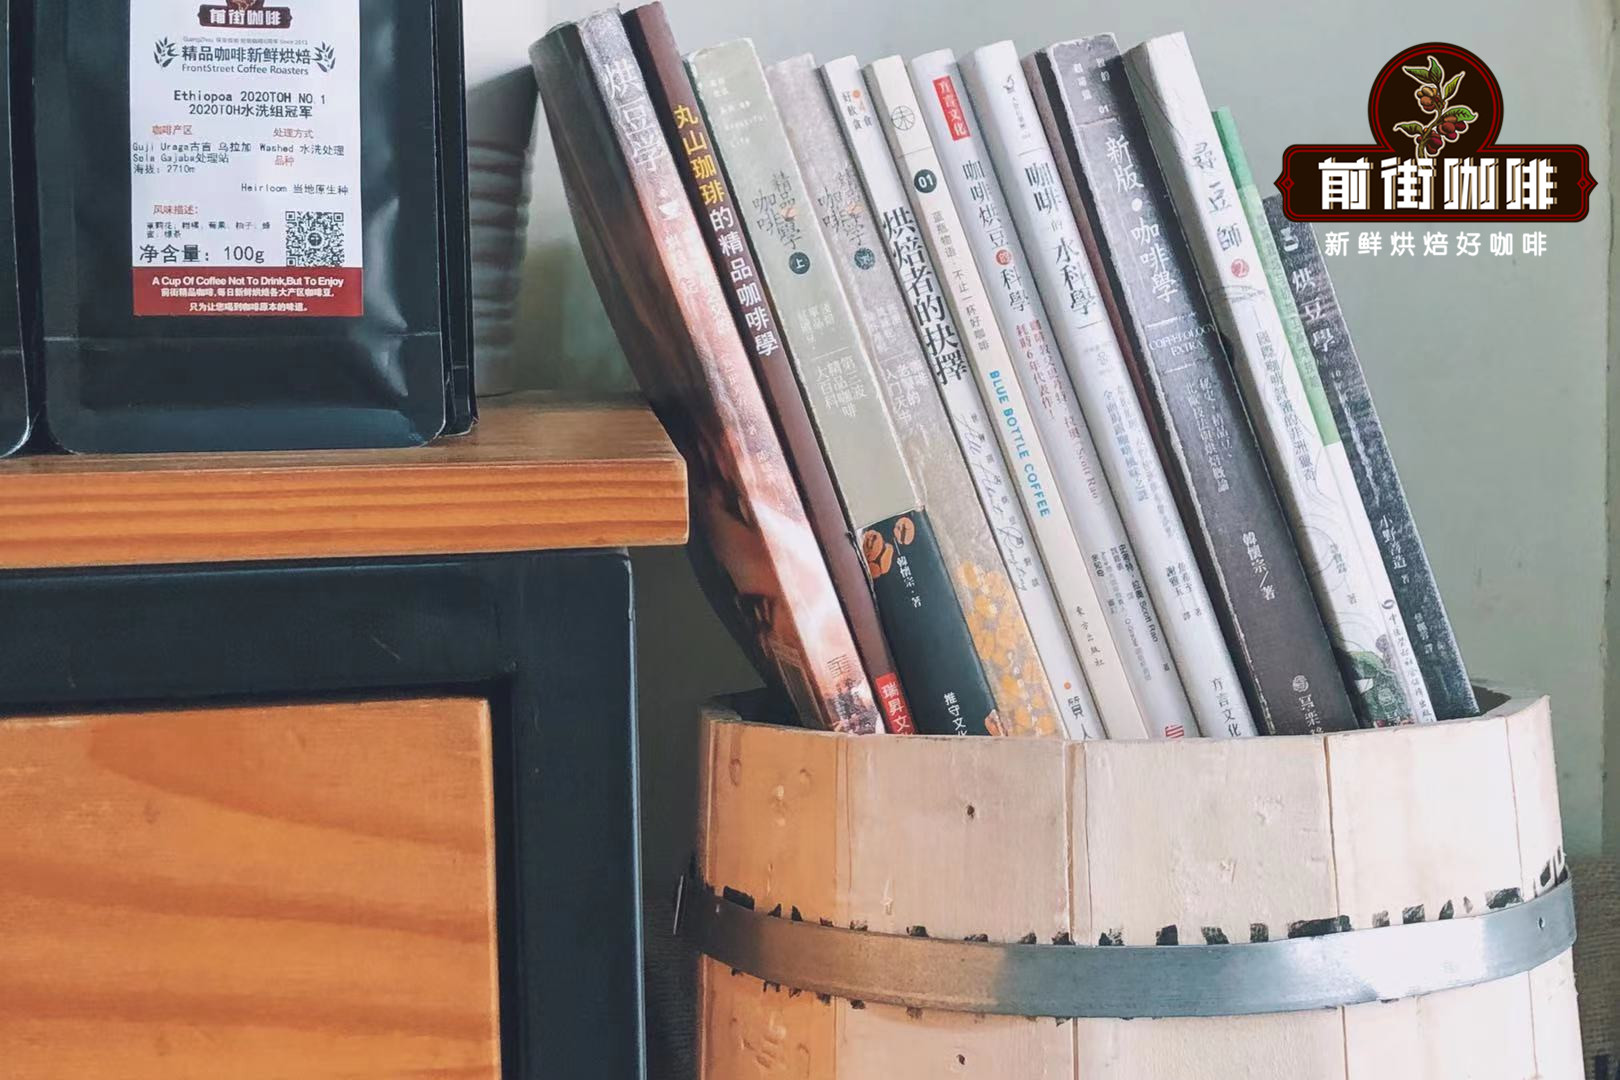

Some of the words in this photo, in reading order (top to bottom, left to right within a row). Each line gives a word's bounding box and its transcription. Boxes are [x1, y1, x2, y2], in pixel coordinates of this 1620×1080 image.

[209, 8, 282, 26] 前街咖啡
[182, 45, 312, 64] 精品咖啡新鲜烘焙
[182, 64, 235, 73] FrontStreet
[237, 65, 267, 73] Coffee
[270, 66, 309, 75] Roasters
[174, 90, 232, 103] Ethiopoa
[241, 91, 292, 103] 2020TOH
[189, 105, 313, 118] 2020TOH水洗组冠军
[152, 124, 193, 135] 咖啡产区
[273, 128, 314, 139] 处理方式
[259, 143, 294, 153] Washed
[299, 144, 345, 156] 水洗处理
[274, 155, 295, 167] 品种
[918, 174, 935, 189] 01
[241, 183, 288, 193] Heirloom
[293, 183, 349, 196] 当地原生种
[223, 245, 266, 264] 100g
[152, 276, 160, 286] A
[161, 276, 182, 288] Cup
[183, 276, 194, 286] Of
[195, 276, 227, 286] Coffee
[228, 276, 245, 286] Not
[246, 276, 259, 286] To
[304, 277, 317, 287] To
[318, 277, 345, 288] Enjoy
[989, 370, 1009, 405] BLUE
[1003, 407, 1030, 460] BOTTLE
[1024, 463, 1051, 518] COFFEE
[1149, 624, 1159, 643] Rao
